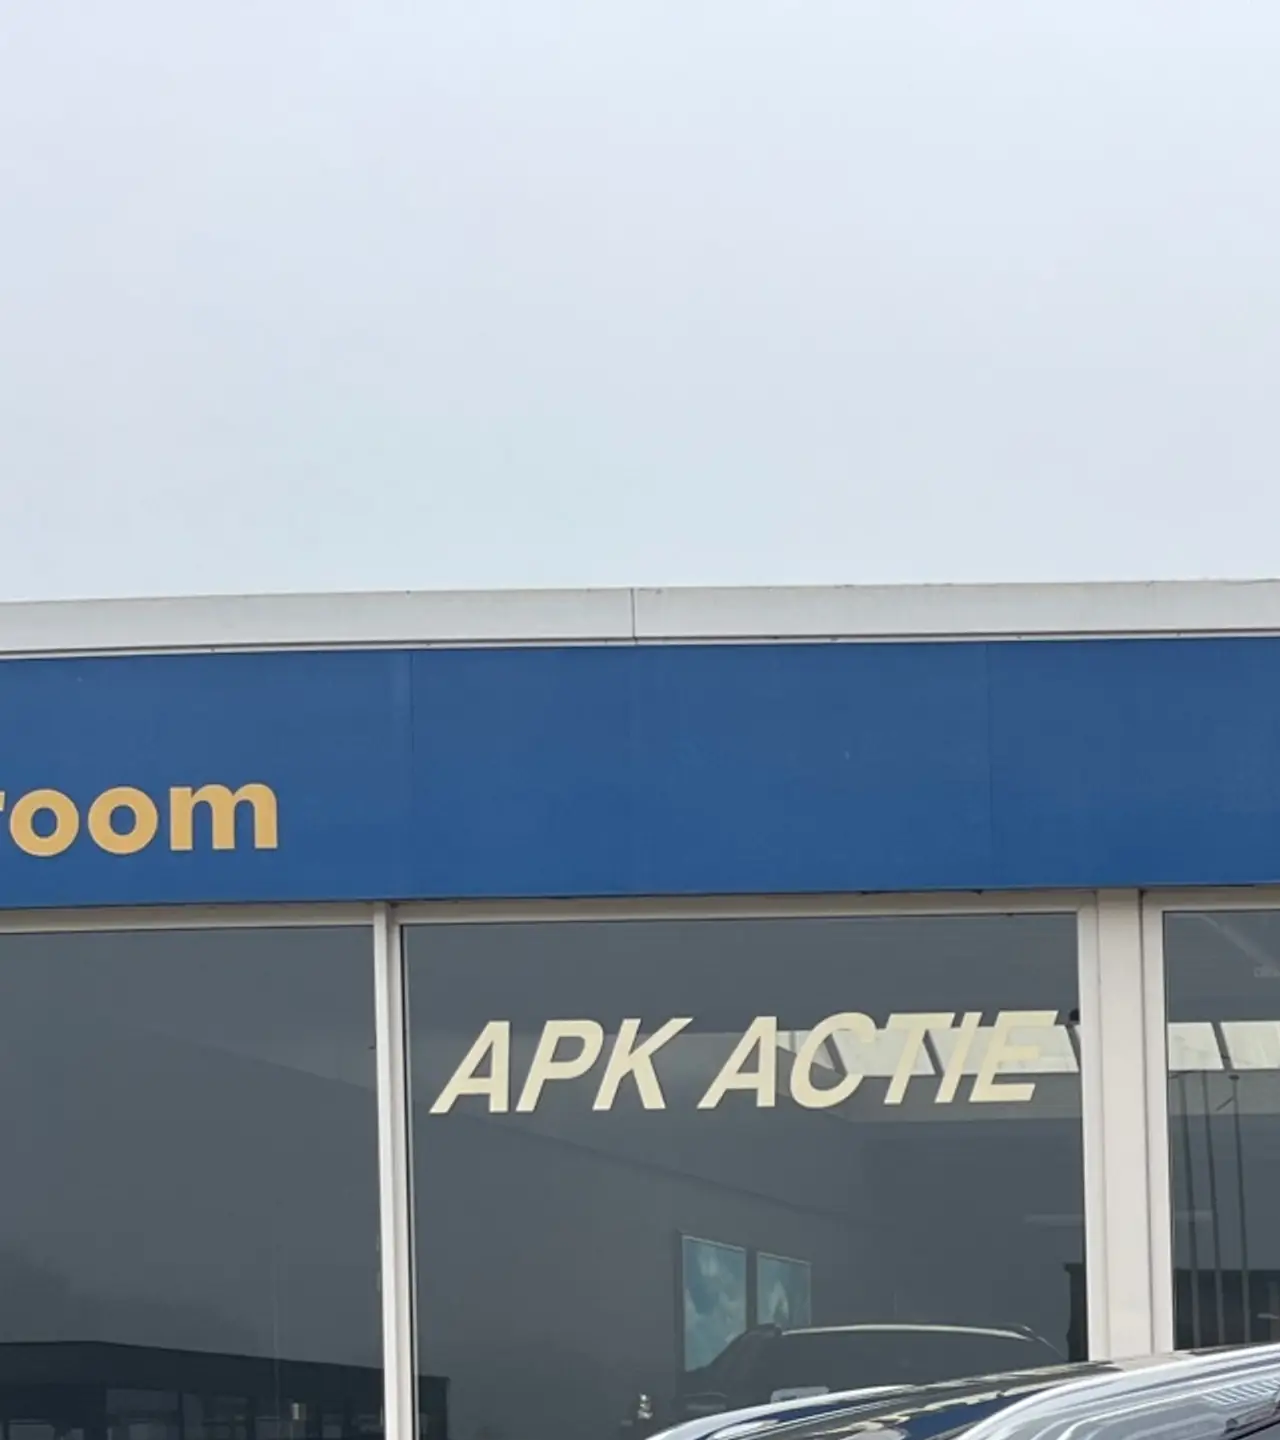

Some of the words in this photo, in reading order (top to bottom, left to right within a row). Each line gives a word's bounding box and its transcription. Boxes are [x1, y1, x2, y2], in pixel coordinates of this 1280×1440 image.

[0, 783, 278, 857] oom
[428, 1017, 694, 1114] APK
[696, 1010, 1059, 1109] ACTIE
